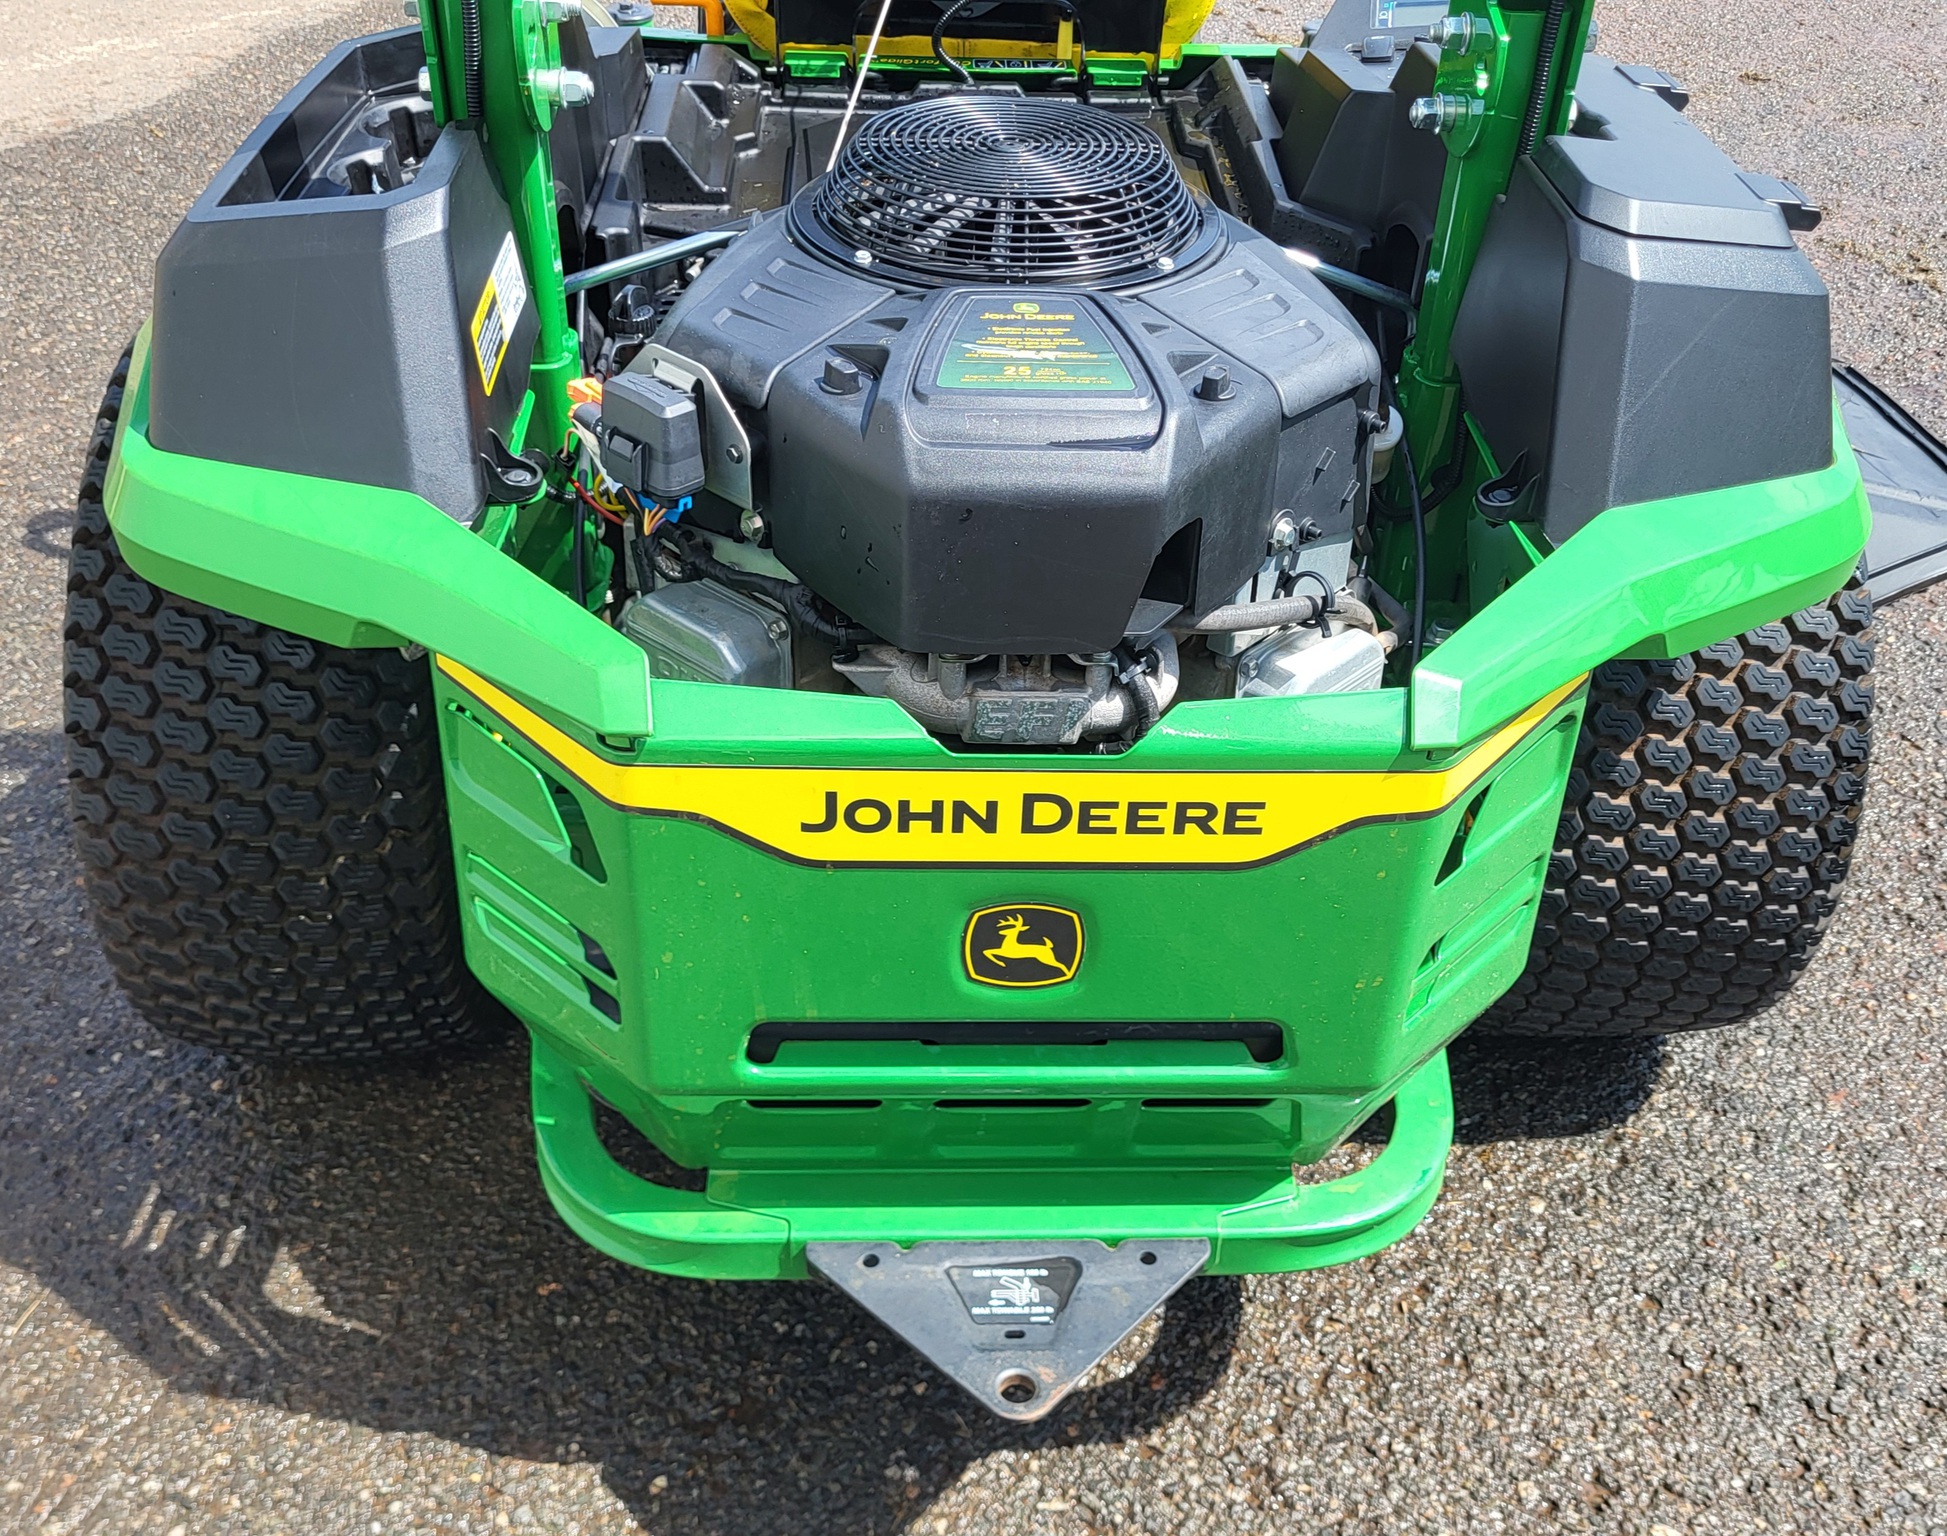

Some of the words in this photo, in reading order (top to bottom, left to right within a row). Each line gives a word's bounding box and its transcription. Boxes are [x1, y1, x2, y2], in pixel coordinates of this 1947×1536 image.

[980, 312, 1022, 321] JOHN
[1024, 313, 1075, 321] DEERE
[1003, 365, 1032, 376] 25
[973, 697, 1090, 743] EFI
[799, 790, 999, 835] JOHN
[1019, 791, 1268, 836] DEERE
